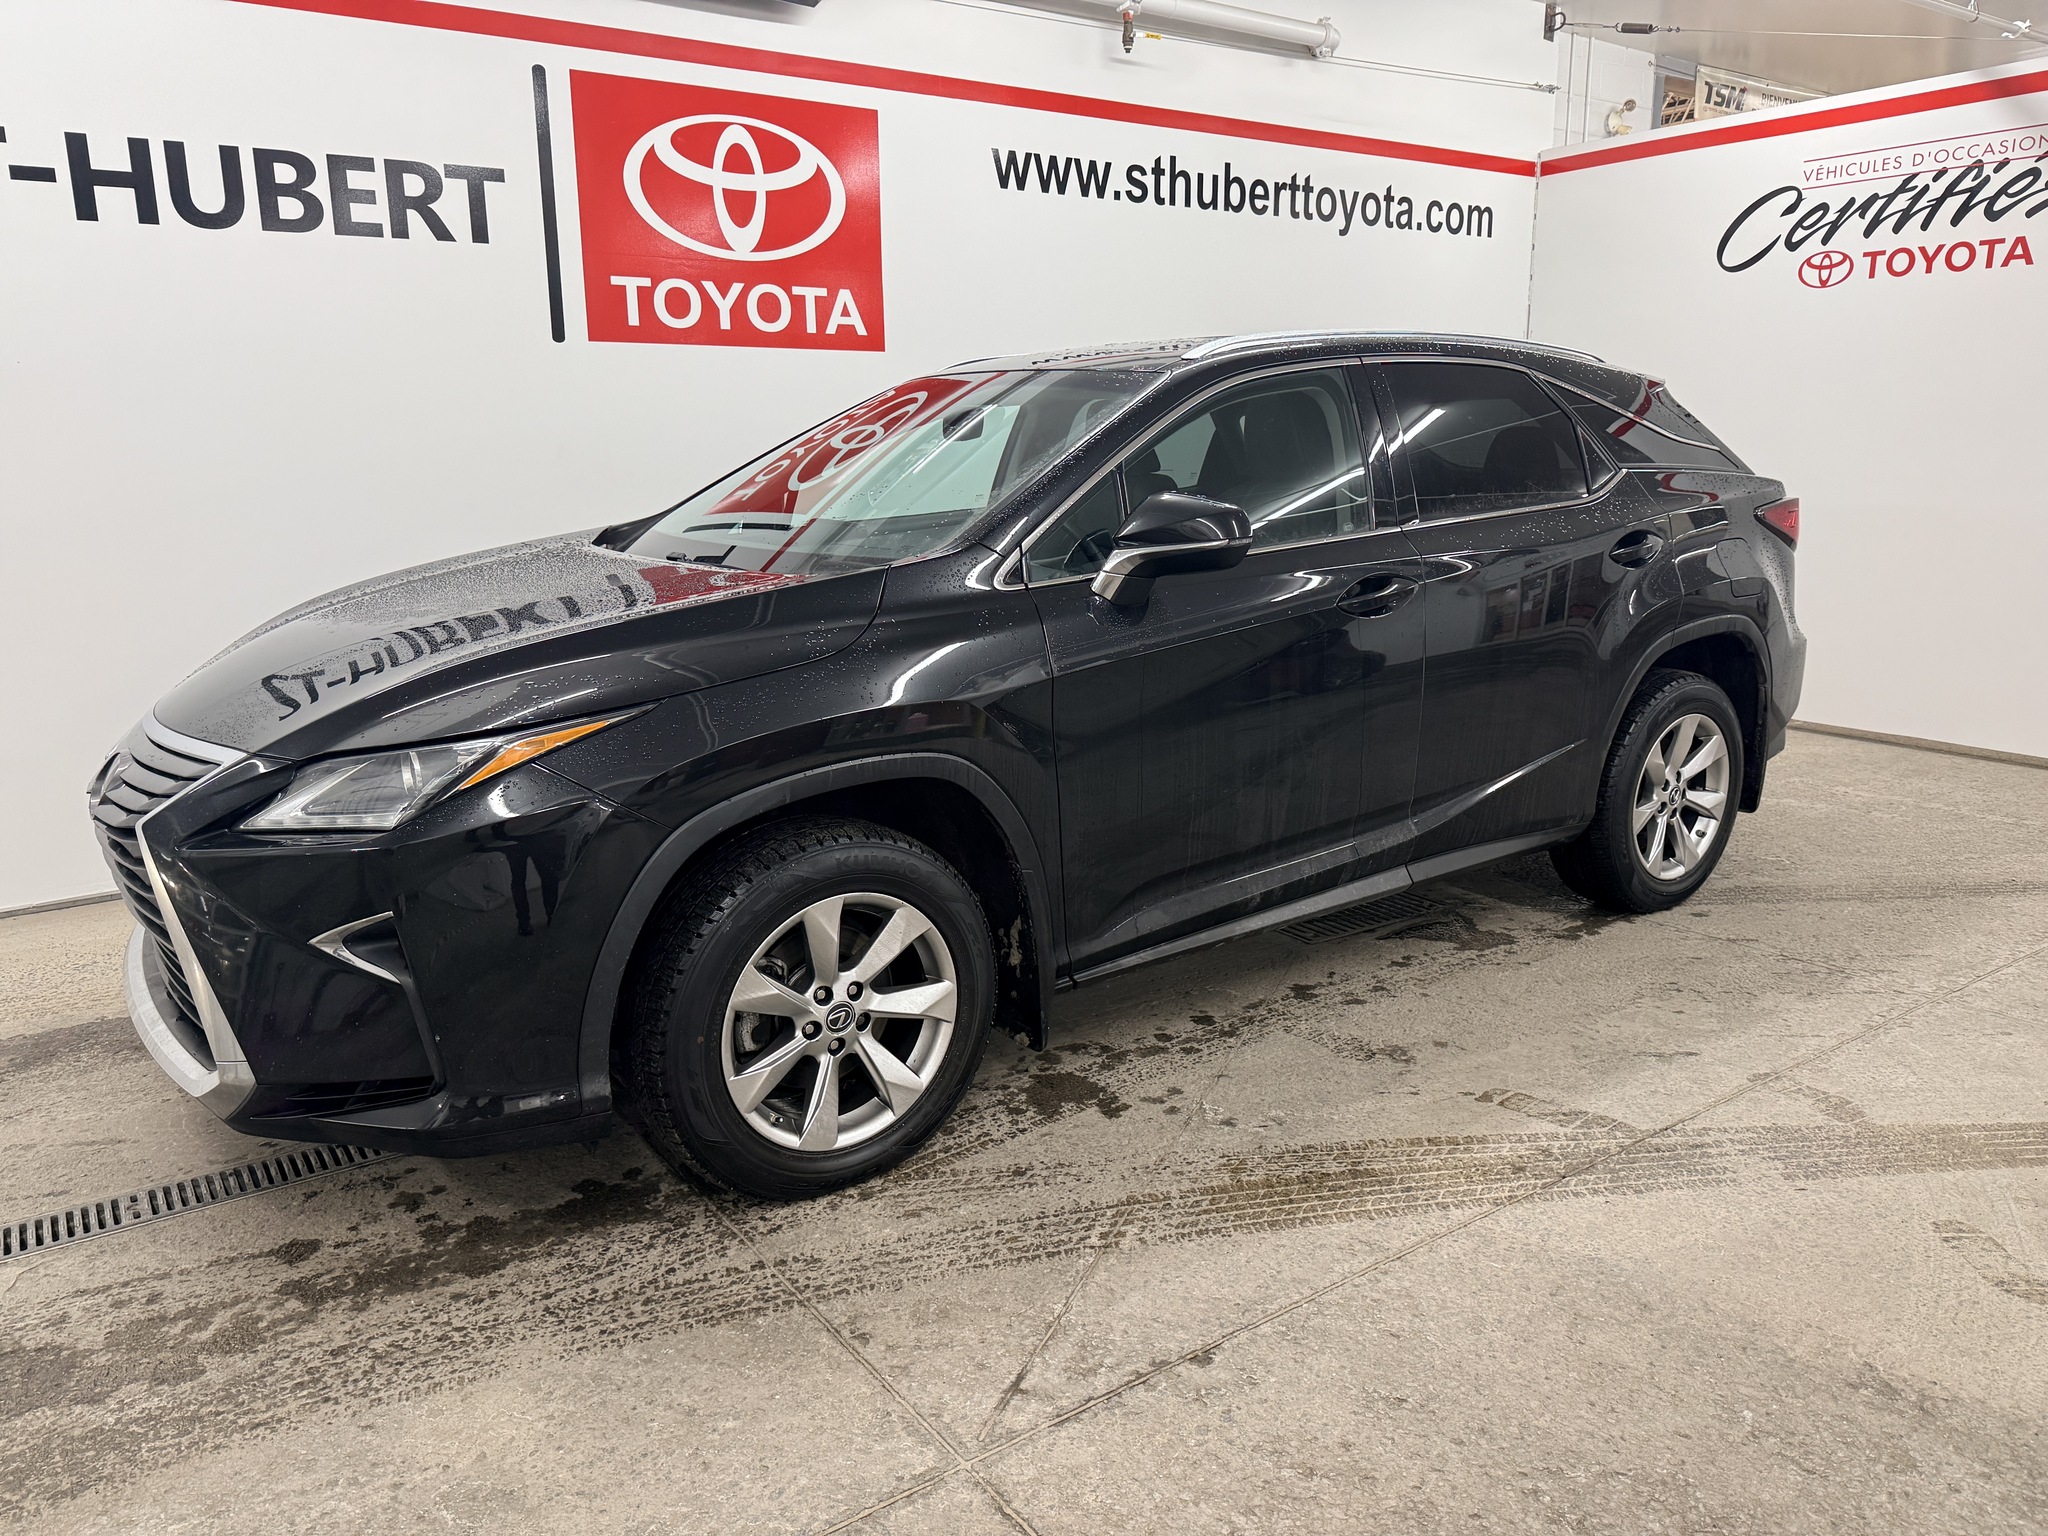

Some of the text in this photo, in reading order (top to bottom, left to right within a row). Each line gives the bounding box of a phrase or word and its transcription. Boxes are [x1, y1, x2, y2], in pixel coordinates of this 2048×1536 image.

[0, 125, 506, 245] -HUBERT
[992, 148, 1494, 238] www.sthuberttoyota.com
[1803, 155, 1903, 183] VÉHICULES
[1863, 235, 2034, 279] TOYOTA
[610, 275, 868, 336] TOYOTA
